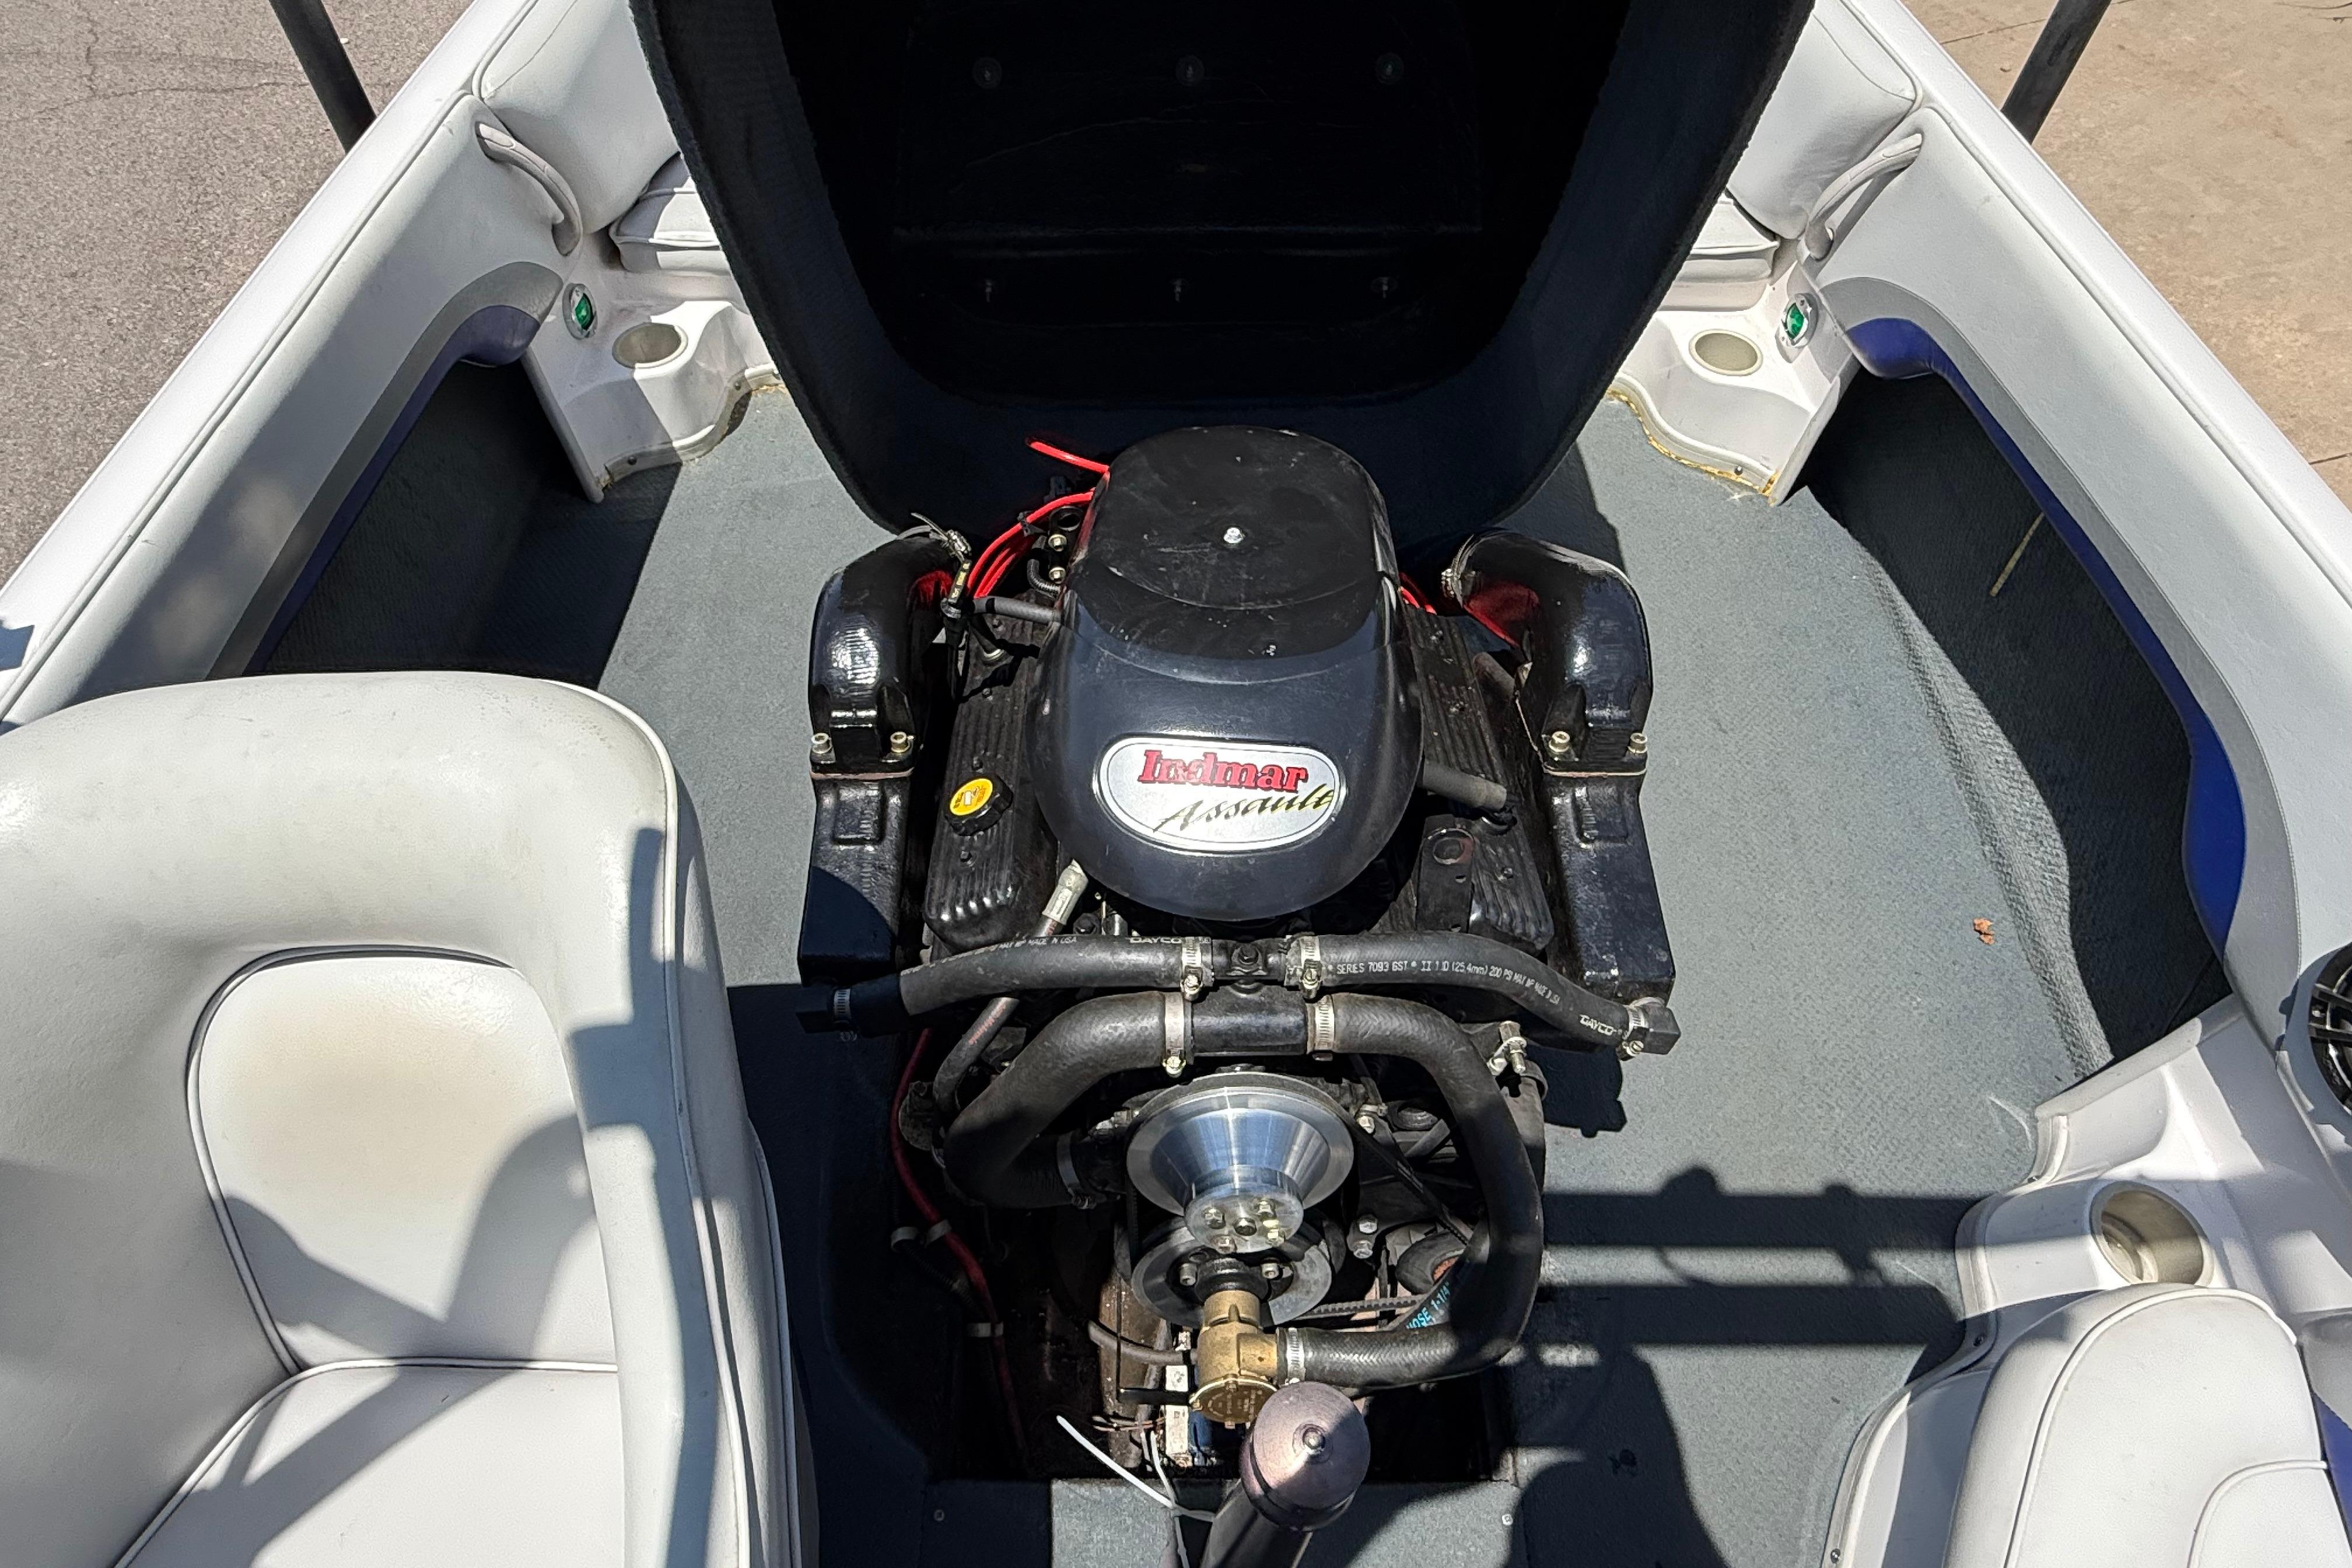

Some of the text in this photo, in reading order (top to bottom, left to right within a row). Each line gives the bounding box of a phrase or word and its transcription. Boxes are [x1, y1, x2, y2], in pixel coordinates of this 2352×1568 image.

[1138, 750, 1308, 793] Indmar
[1153, 783, 1335, 832] Assault
[1125, 936, 1182, 944] DAYCO
[1336, 963, 1365, 974] SERIES
[1368, 961, 1390, 972] 7093
[1489, 965, 1503, 978] 200
